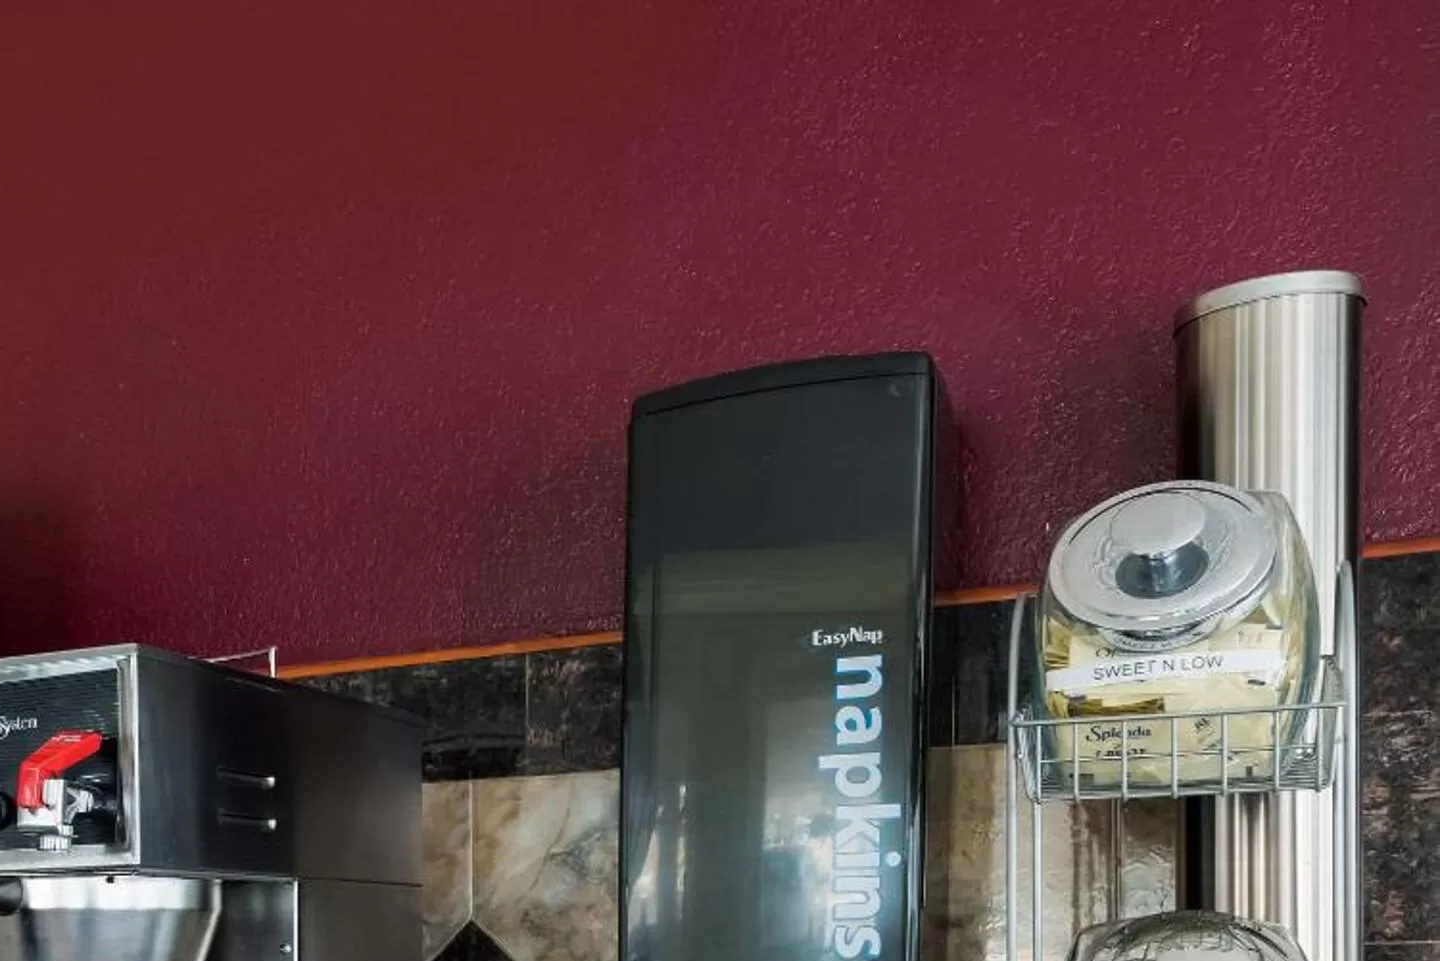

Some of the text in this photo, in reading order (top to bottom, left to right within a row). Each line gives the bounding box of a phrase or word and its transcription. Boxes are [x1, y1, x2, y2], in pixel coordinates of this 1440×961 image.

[812, 625, 883, 648] EasyNap
[1093, 655, 1224, 681] SWEET N LOW
[818, 653, 902, 960] napkins
